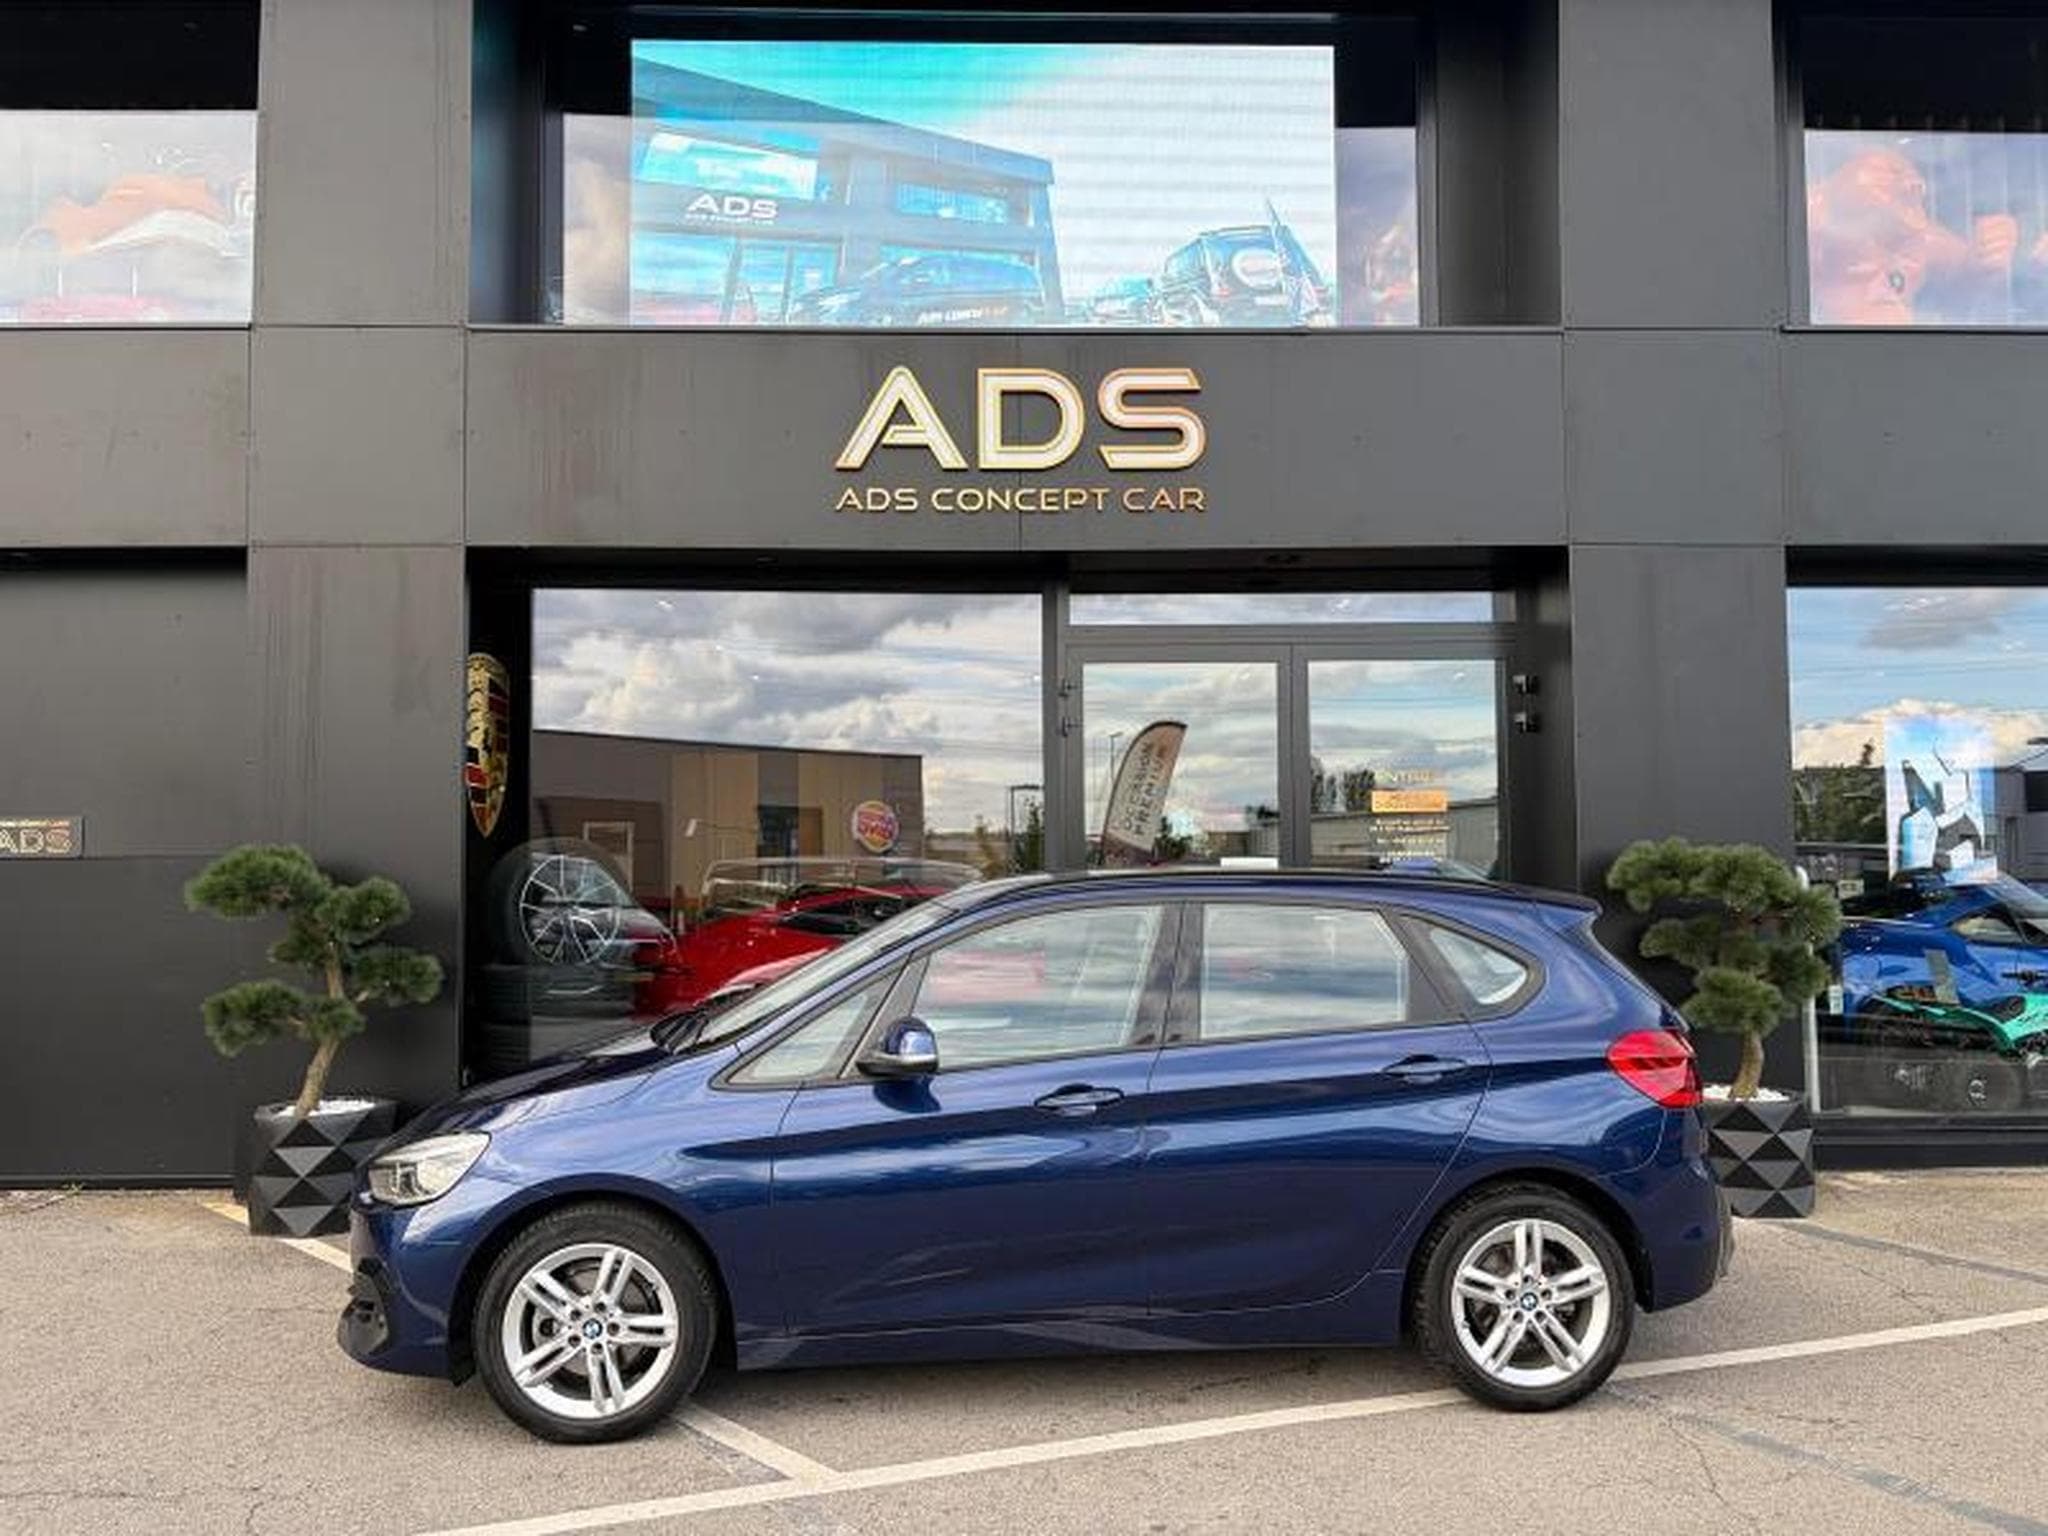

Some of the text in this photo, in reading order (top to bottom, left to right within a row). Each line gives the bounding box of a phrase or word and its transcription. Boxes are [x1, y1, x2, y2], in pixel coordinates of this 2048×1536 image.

[687, 193, 777, 219] ADS
[835, 366, 1206, 470] ADS
[835, 487, 1206, 512] ADS CONCEPT CAR
